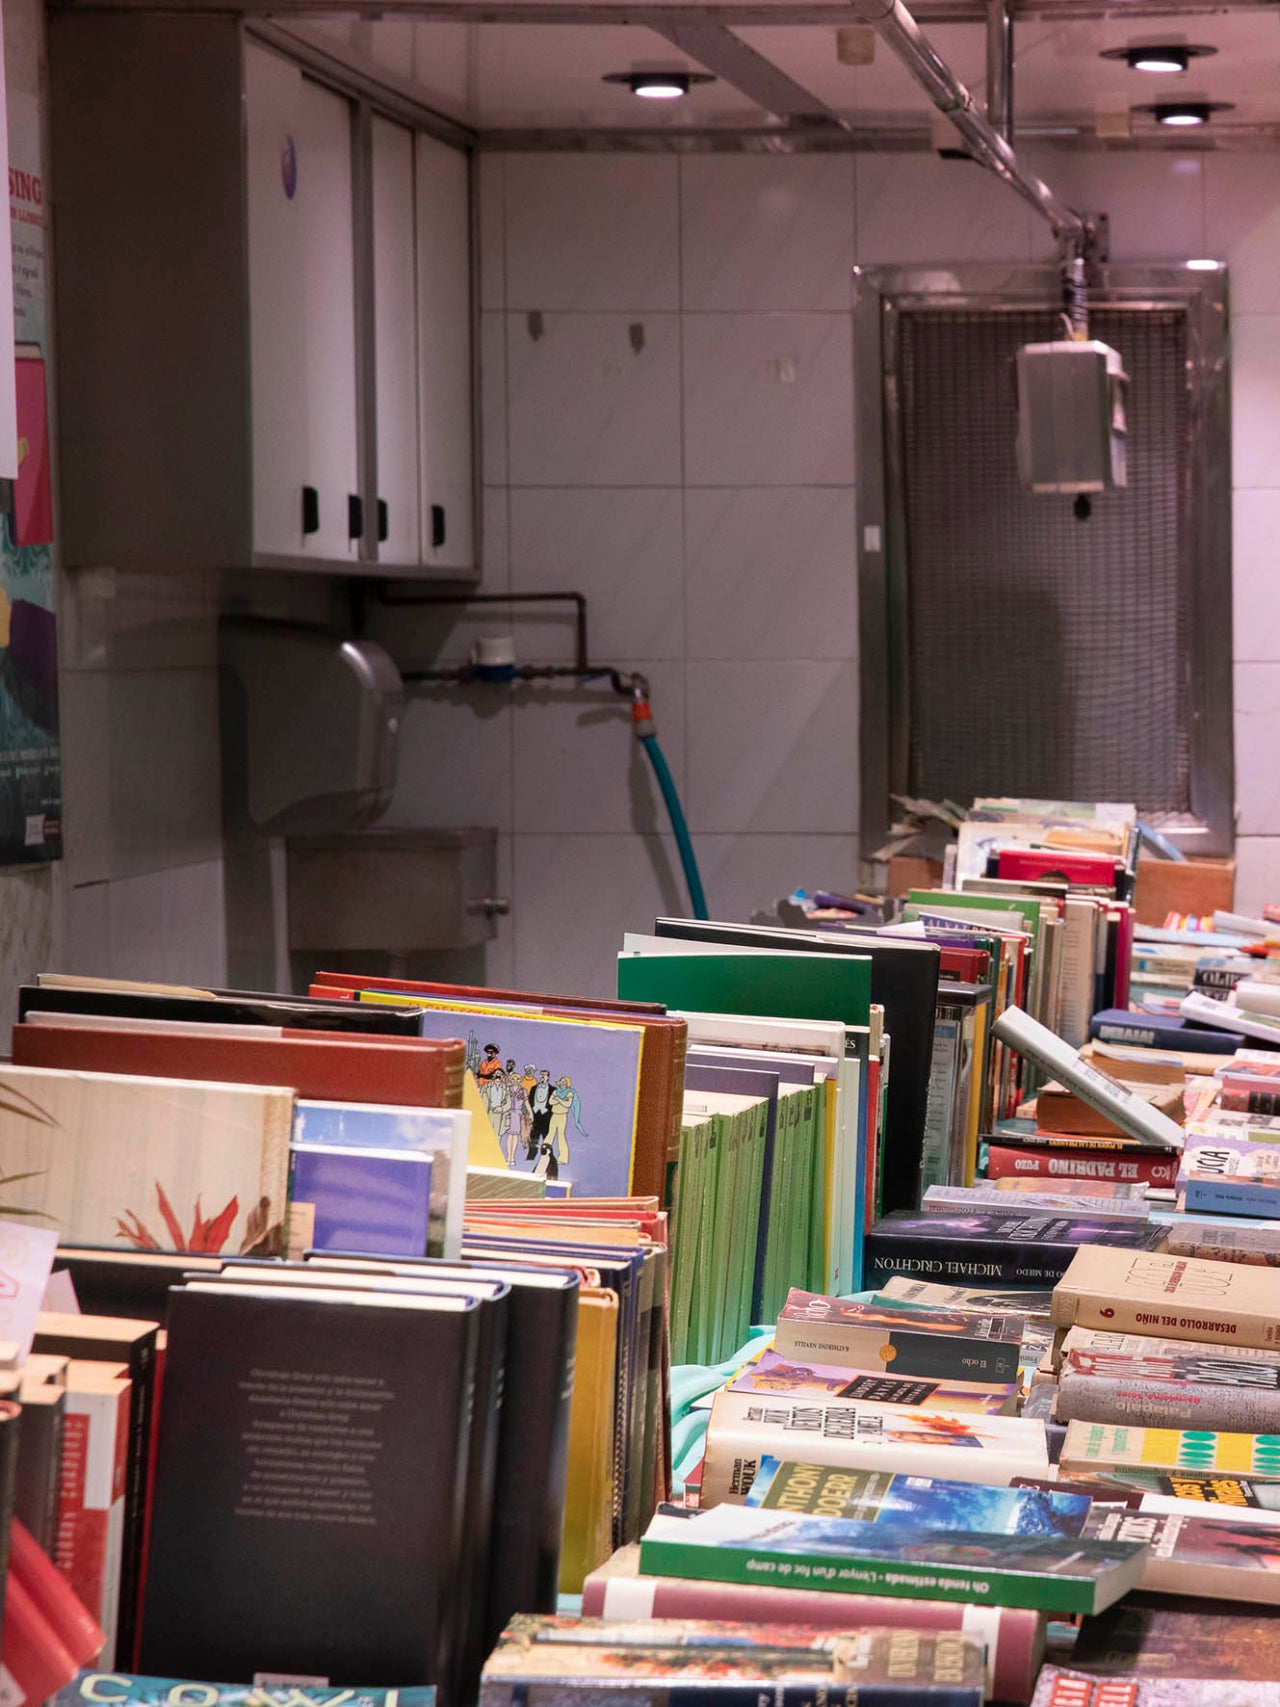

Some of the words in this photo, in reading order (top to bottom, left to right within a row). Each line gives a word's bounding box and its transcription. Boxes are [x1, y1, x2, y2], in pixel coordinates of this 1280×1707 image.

[1014, 1159, 1040, 1171] PUZO
[1048, 1158, 1116, 1178] PADRINO
[1118, 1162, 1139, 1179] EL
[874, 1256, 943, 1272] CRICHTON
[944, 1261, 1003, 1277] MICHAEL
[1016, 1267, 1042, 1278] MIEDO
[1042, 1269, 1055, 1278] DE
[1136, 1312, 1159, 1328] NIÑO
[1161, 1315, 1177, 1328] DEL
[1179, 1317, 1237, 1334] DESARROLLO
[795, 1340, 818, 1349] NEVILLE
[818, 1343, 849, 1352] KATHERINE
[962, 1357, 980, 1367] ocho
[979, 1359, 987, 1368] El
[728, 1458, 742, 1495] Herman
[776, 1461, 825, 1513] NTHONY
[812, 1473, 858, 1518] DOERR
[746, 1559, 776, 1573] camp
[777, 1562, 792, 1575] de
[793, 1564, 811, 1578] foc
[812, 1566, 837, 1580] d'un
[885, 1572, 937, 1589] estimada
[939, 1577, 970, 1592] tenda
[972, 1580, 990, 1594] Oh
